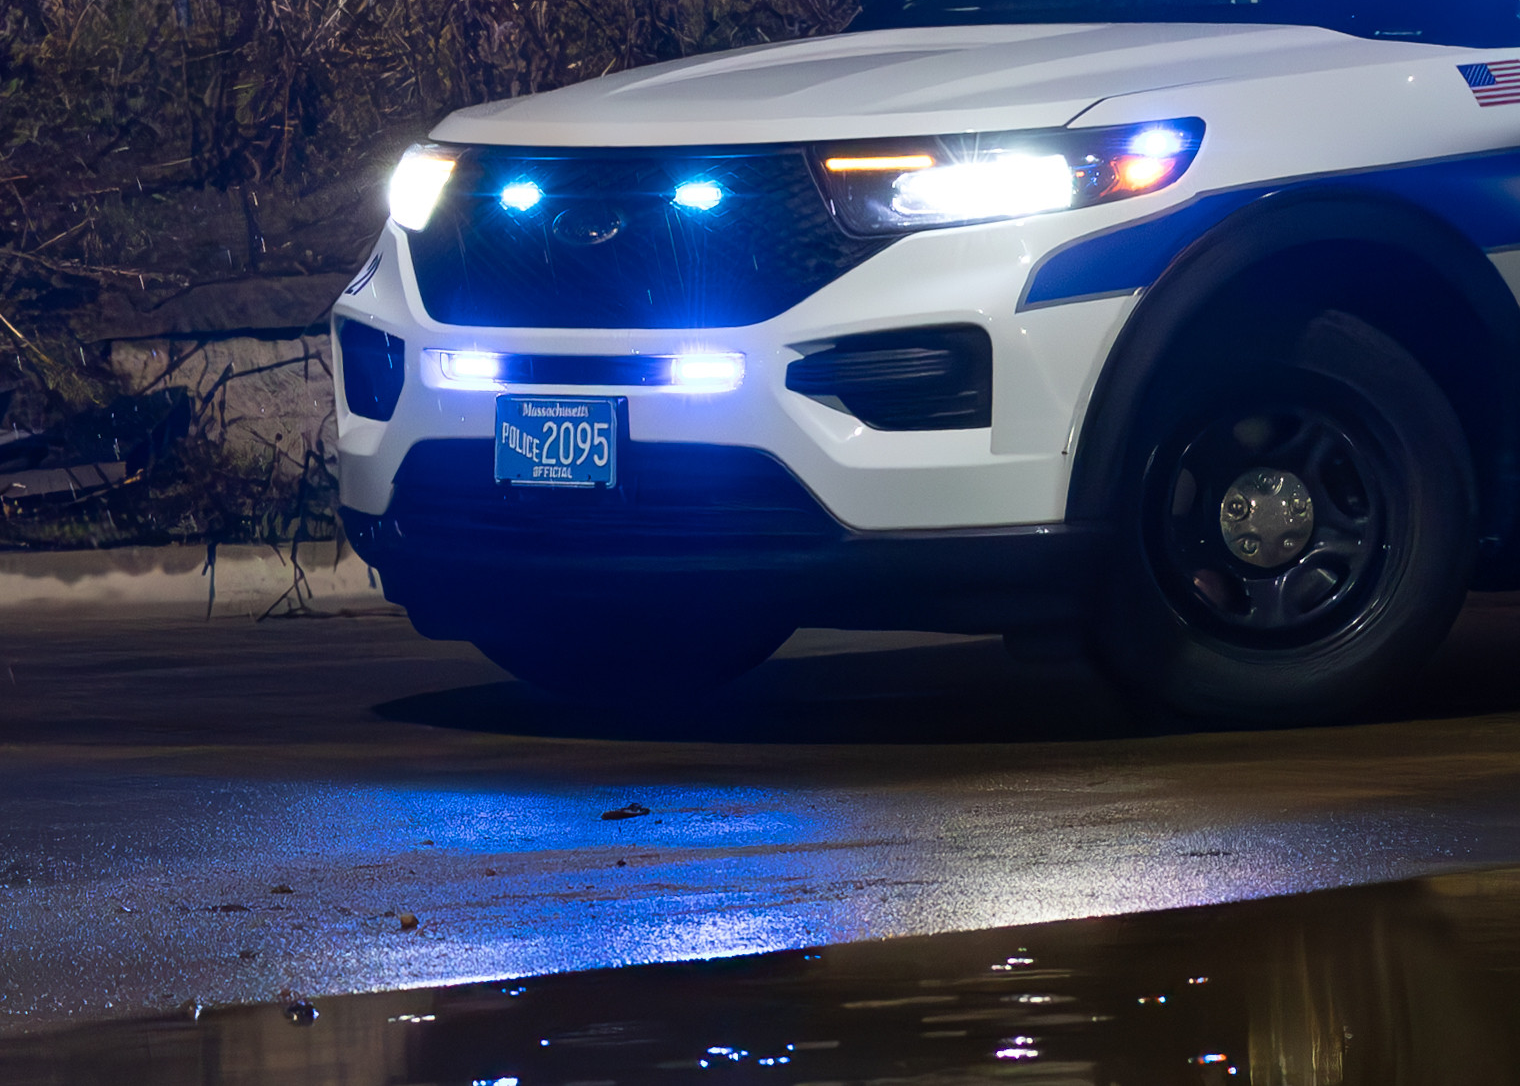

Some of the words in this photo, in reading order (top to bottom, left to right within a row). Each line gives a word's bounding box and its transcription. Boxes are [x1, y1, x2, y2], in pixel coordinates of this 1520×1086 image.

[522, 402, 589, 418] Massachusetts
[502, 421, 541, 463] POLICE
[541, 420, 609, 467] 2095
[532, 466, 573, 479] OFFICIAL
